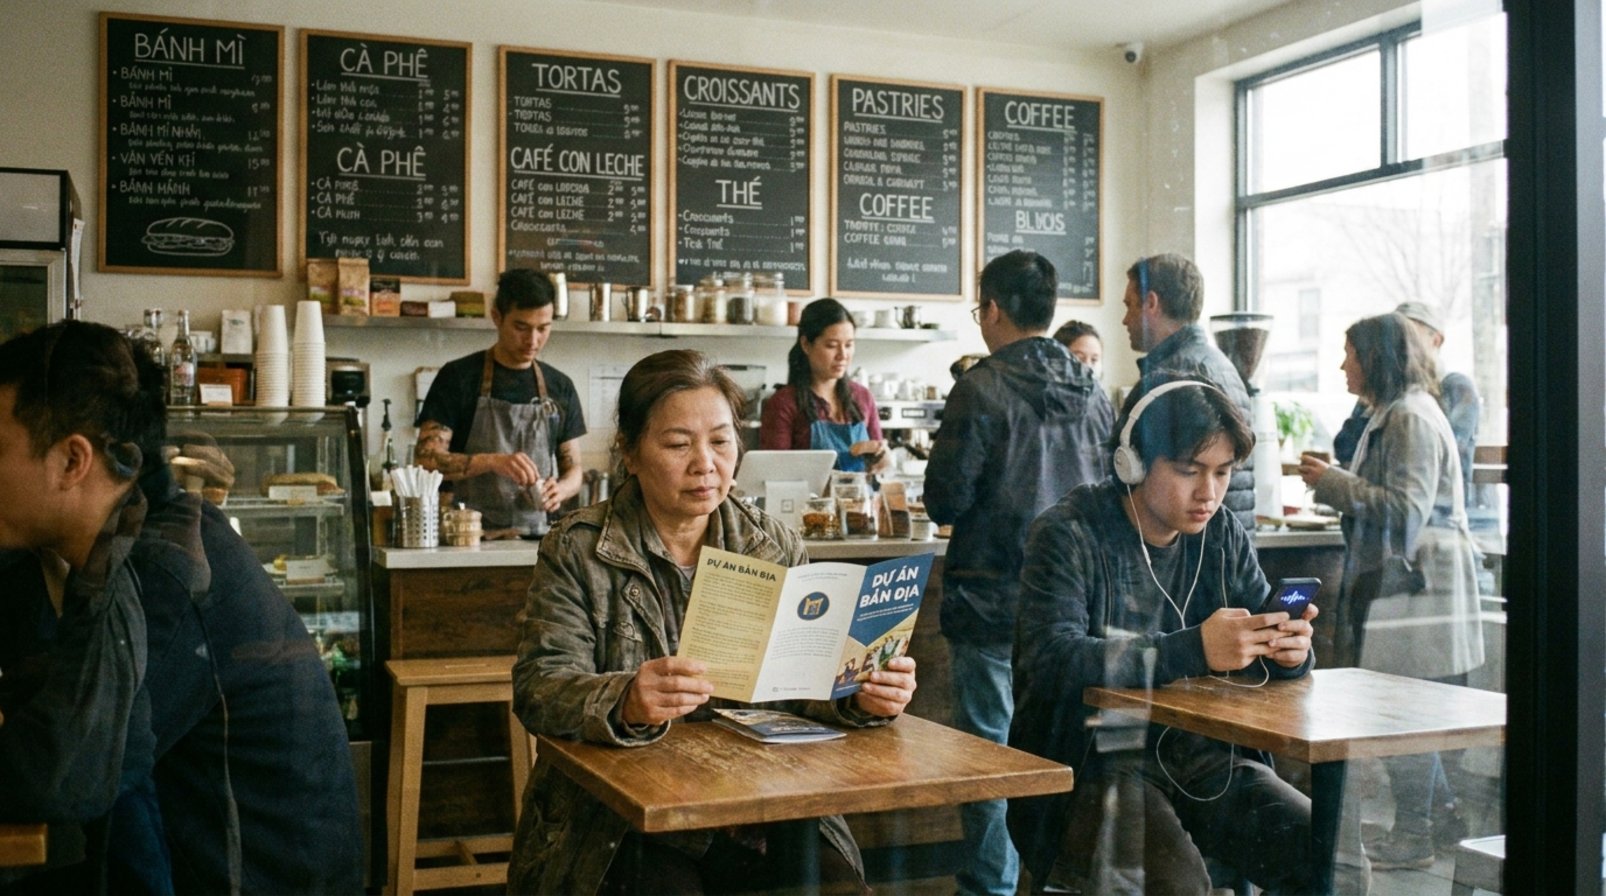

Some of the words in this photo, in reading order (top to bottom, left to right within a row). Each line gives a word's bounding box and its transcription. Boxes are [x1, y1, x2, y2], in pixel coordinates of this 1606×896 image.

[134, 27, 205, 63] BÁNH
[216, 33, 247, 65] MÌ
[340, 42, 374, 73] CÀ
[384, 48, 429, 79] PHÊ
[531, 63, 622, 94] TORTAS
[683, 74, 801, 110] CROISSANTS
[852, 87, 945, 120] PASTRIES
[1004, 100, 1076, 130] COFFEE
[337, 141, 371, 173] CÀ
[381, 145, 427, 177] PHÊ
[510, 143, 554, 171] CAFÉ
[559, 150, 592, 173] CON
[596, 152, 645, 177] LECHE
[715, 176, 762, 206] THÉ
[859, 192, 935, 221] COFFEE
[895, 564, 920, 583] ÁN
